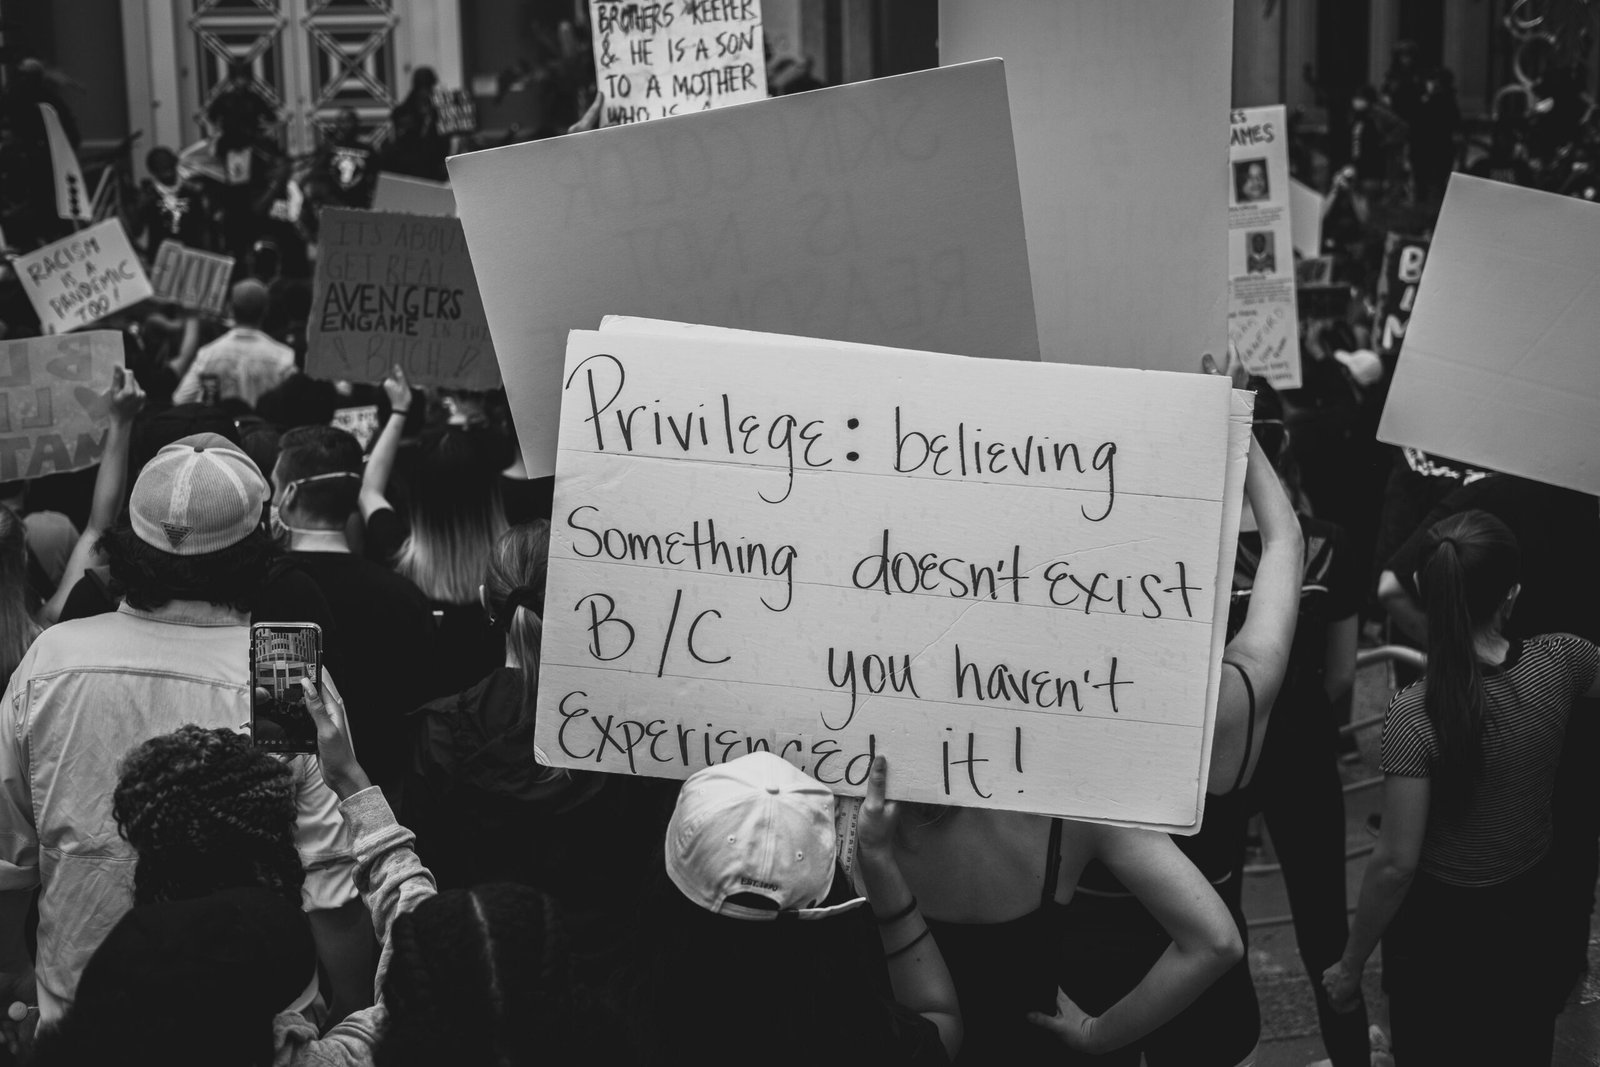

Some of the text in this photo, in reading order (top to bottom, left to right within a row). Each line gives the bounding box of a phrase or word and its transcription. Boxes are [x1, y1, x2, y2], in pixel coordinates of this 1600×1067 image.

[691, 0, 758, 25] KEEPER
[630, 39, 654, 66] HE
[668, 37, 686, 63] IS
[696, 38, 709, 61] A
[715, 25, 755, 58] SON
[605, 62, 758, 98] TO A MOTHER
[1230, 122, 1275, 146] AMES
[27, 237, 101, 288] RACISM
[85, 261, 97, 277] A
[49, 259, 136, 320] PANDEMIC
[320, 313, 419, 337] ENGAME
[566, 354, 1117, 522] Privilege: believing
[567, 505, 798, 612] Something
[852, 529, 1030, 602] doesn't
[820, 646, 920, 731] you
[955, 643, 1134, 713] haven't
